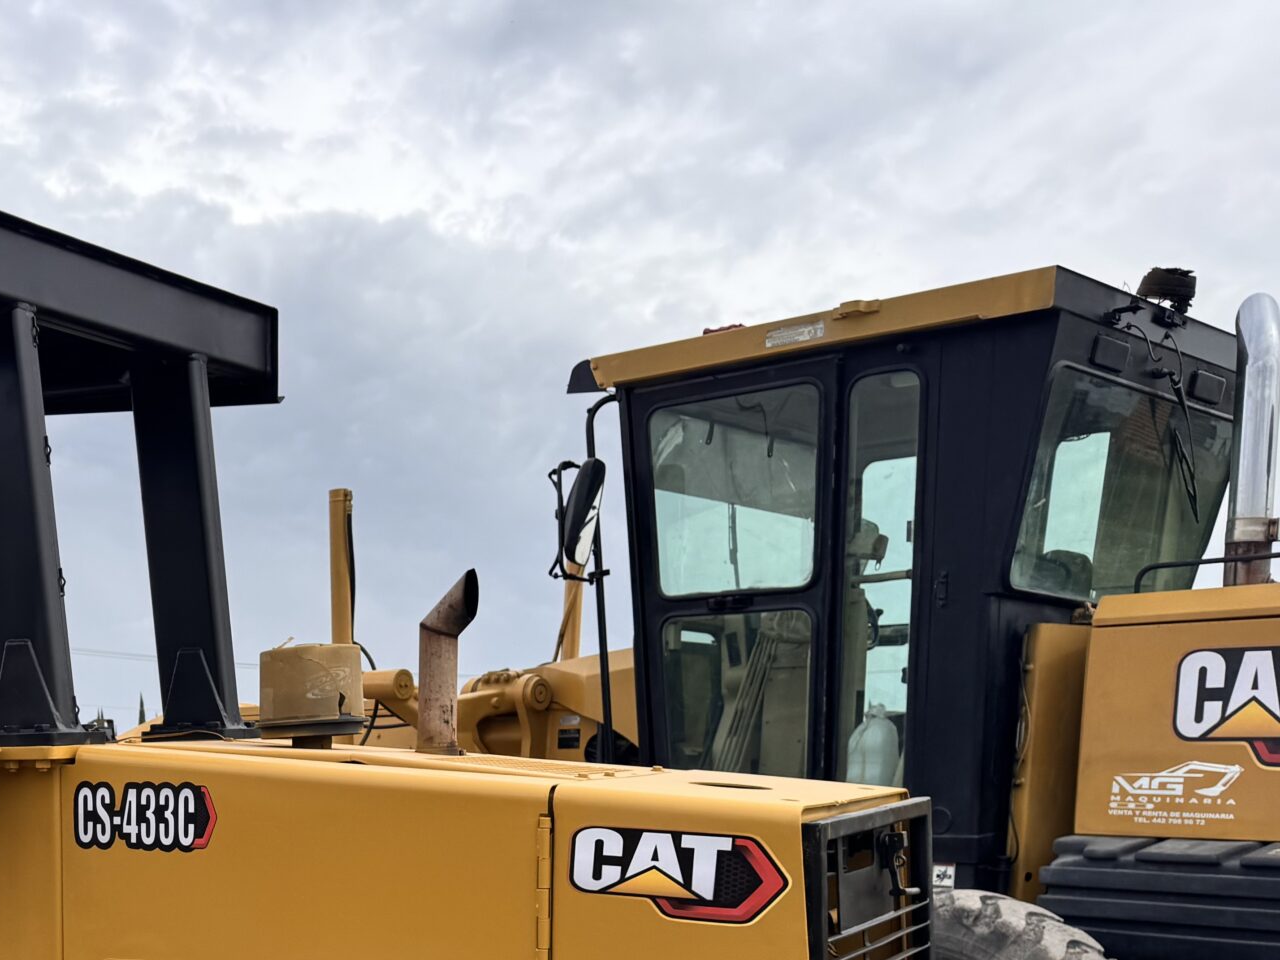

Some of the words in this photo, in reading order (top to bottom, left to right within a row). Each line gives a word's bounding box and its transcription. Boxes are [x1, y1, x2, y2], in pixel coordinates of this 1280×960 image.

[1112, 776, 1184, 795] MG
[1110, 795, 1236, 805] MAQUINARIA
[78, 787, 195, 847] CS-433C
[1142, 810, 1168, 818] RENTA
[1182, 811, 1234, 820] MAQUINARIA
[573, 827, 733, 901] CAT
